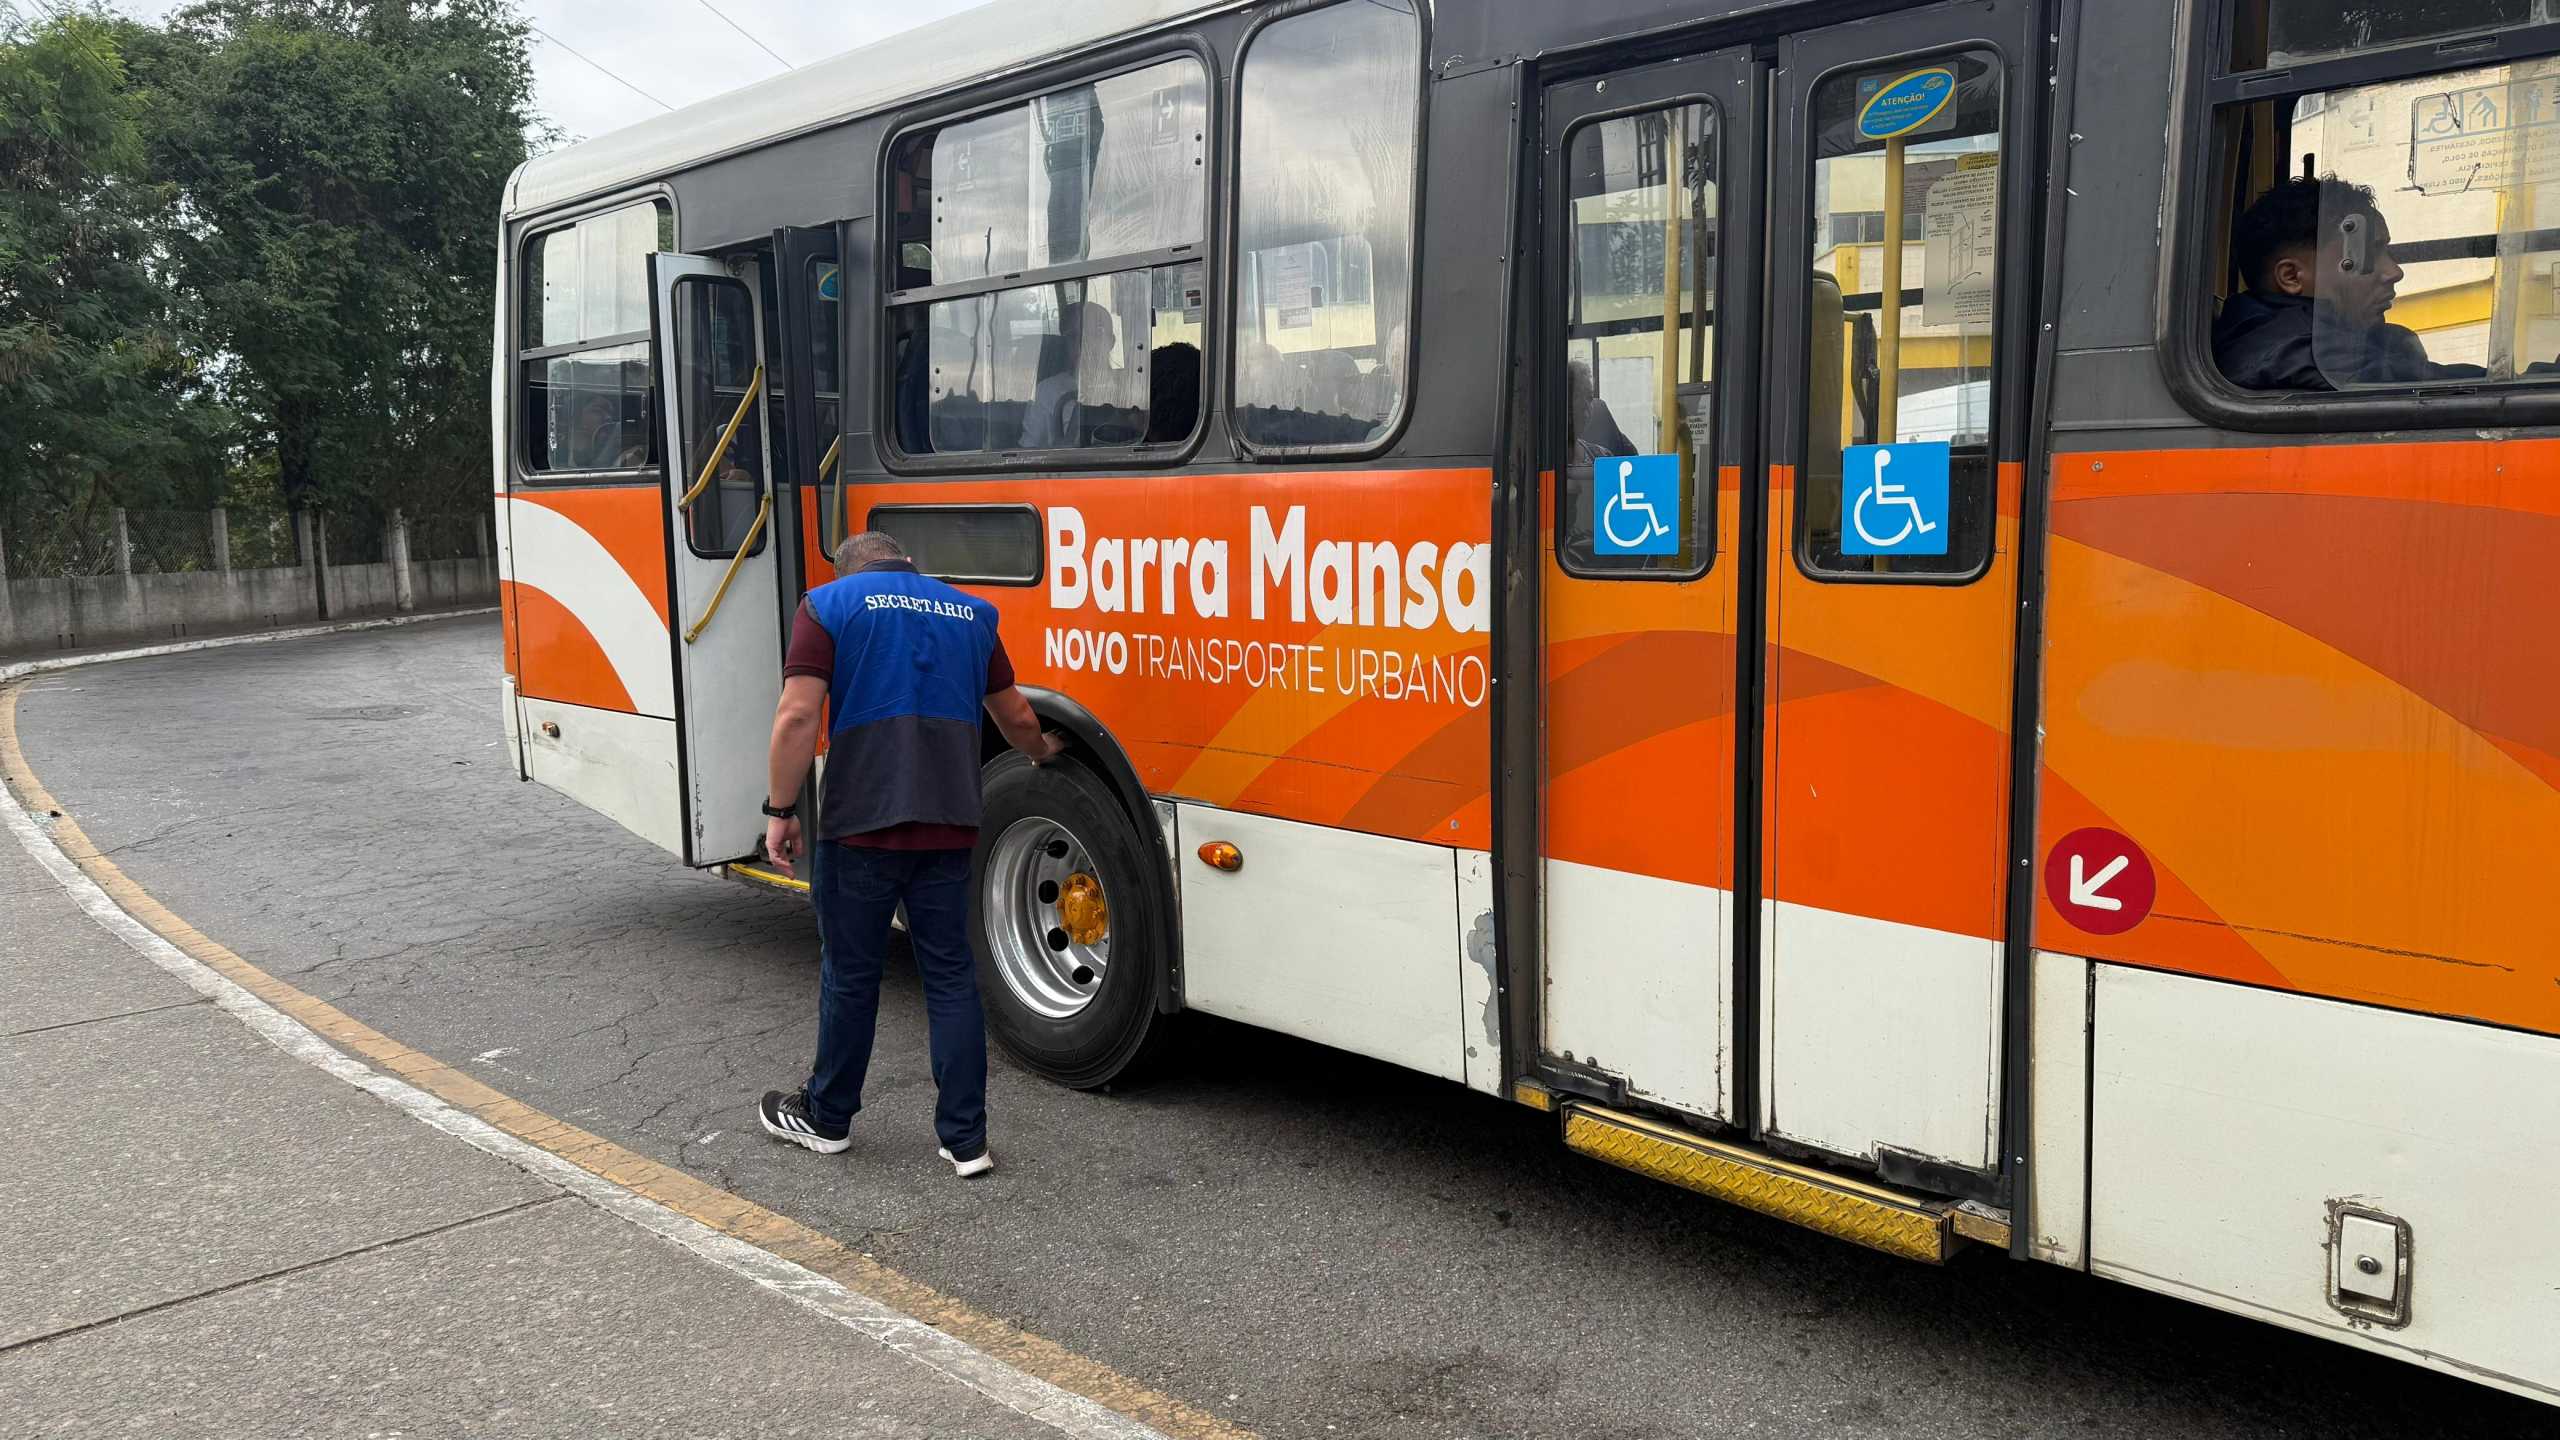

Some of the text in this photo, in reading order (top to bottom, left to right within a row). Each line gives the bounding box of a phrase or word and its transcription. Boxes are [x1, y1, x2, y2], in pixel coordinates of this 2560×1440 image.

[1881, 92, 1925, 106] ATENÇÃO!
[1047, 505, 1491, 633] Barra Mansa
[1045, 627, 1486, 708] NOVO TRANSPORTE URBANO
